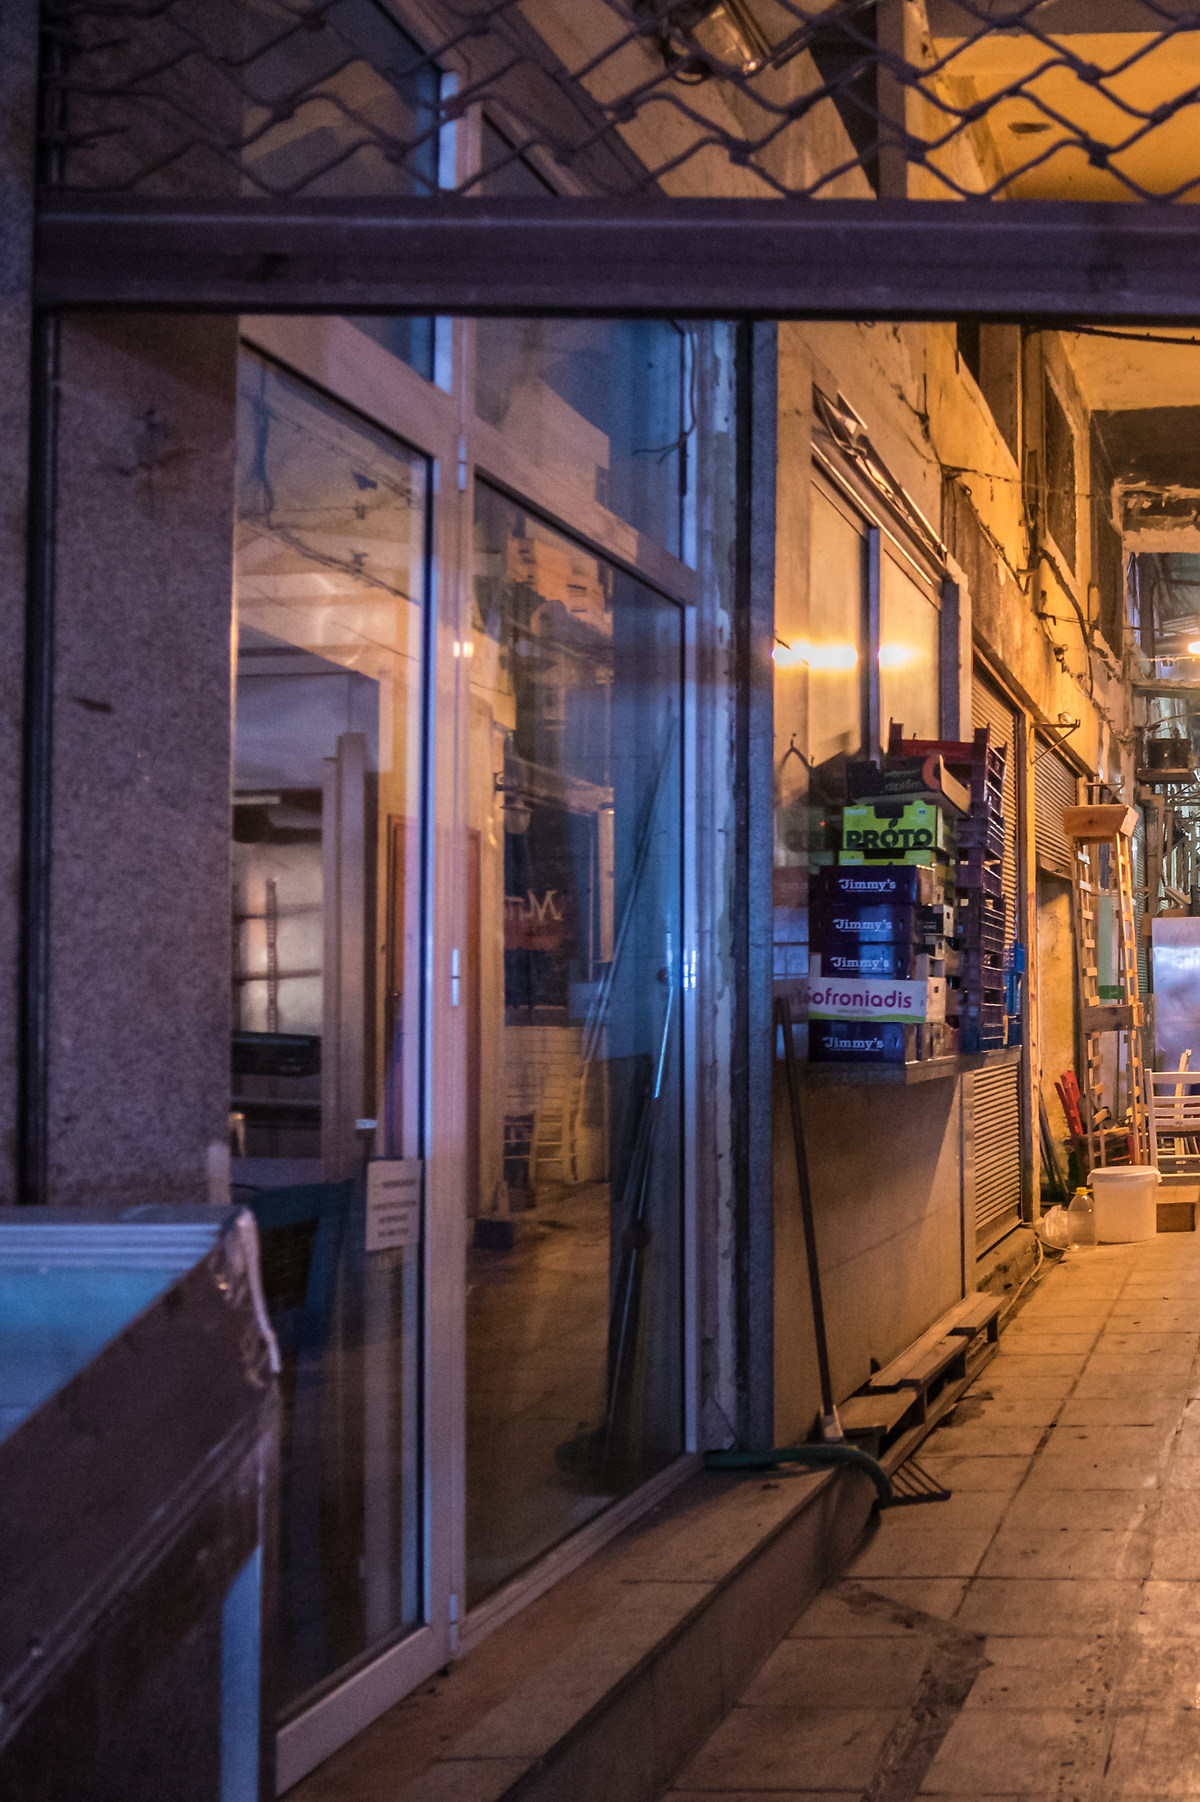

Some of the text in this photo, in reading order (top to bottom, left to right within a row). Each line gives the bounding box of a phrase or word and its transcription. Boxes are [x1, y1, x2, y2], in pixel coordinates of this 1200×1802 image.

[838, 879, 896, 891] Jimmy's
[833, 919, 892, 931] Jimmy's
[830, 957, 889, 970] Jimmy's
[822, 1037, 884, 1050] Jimmy's
